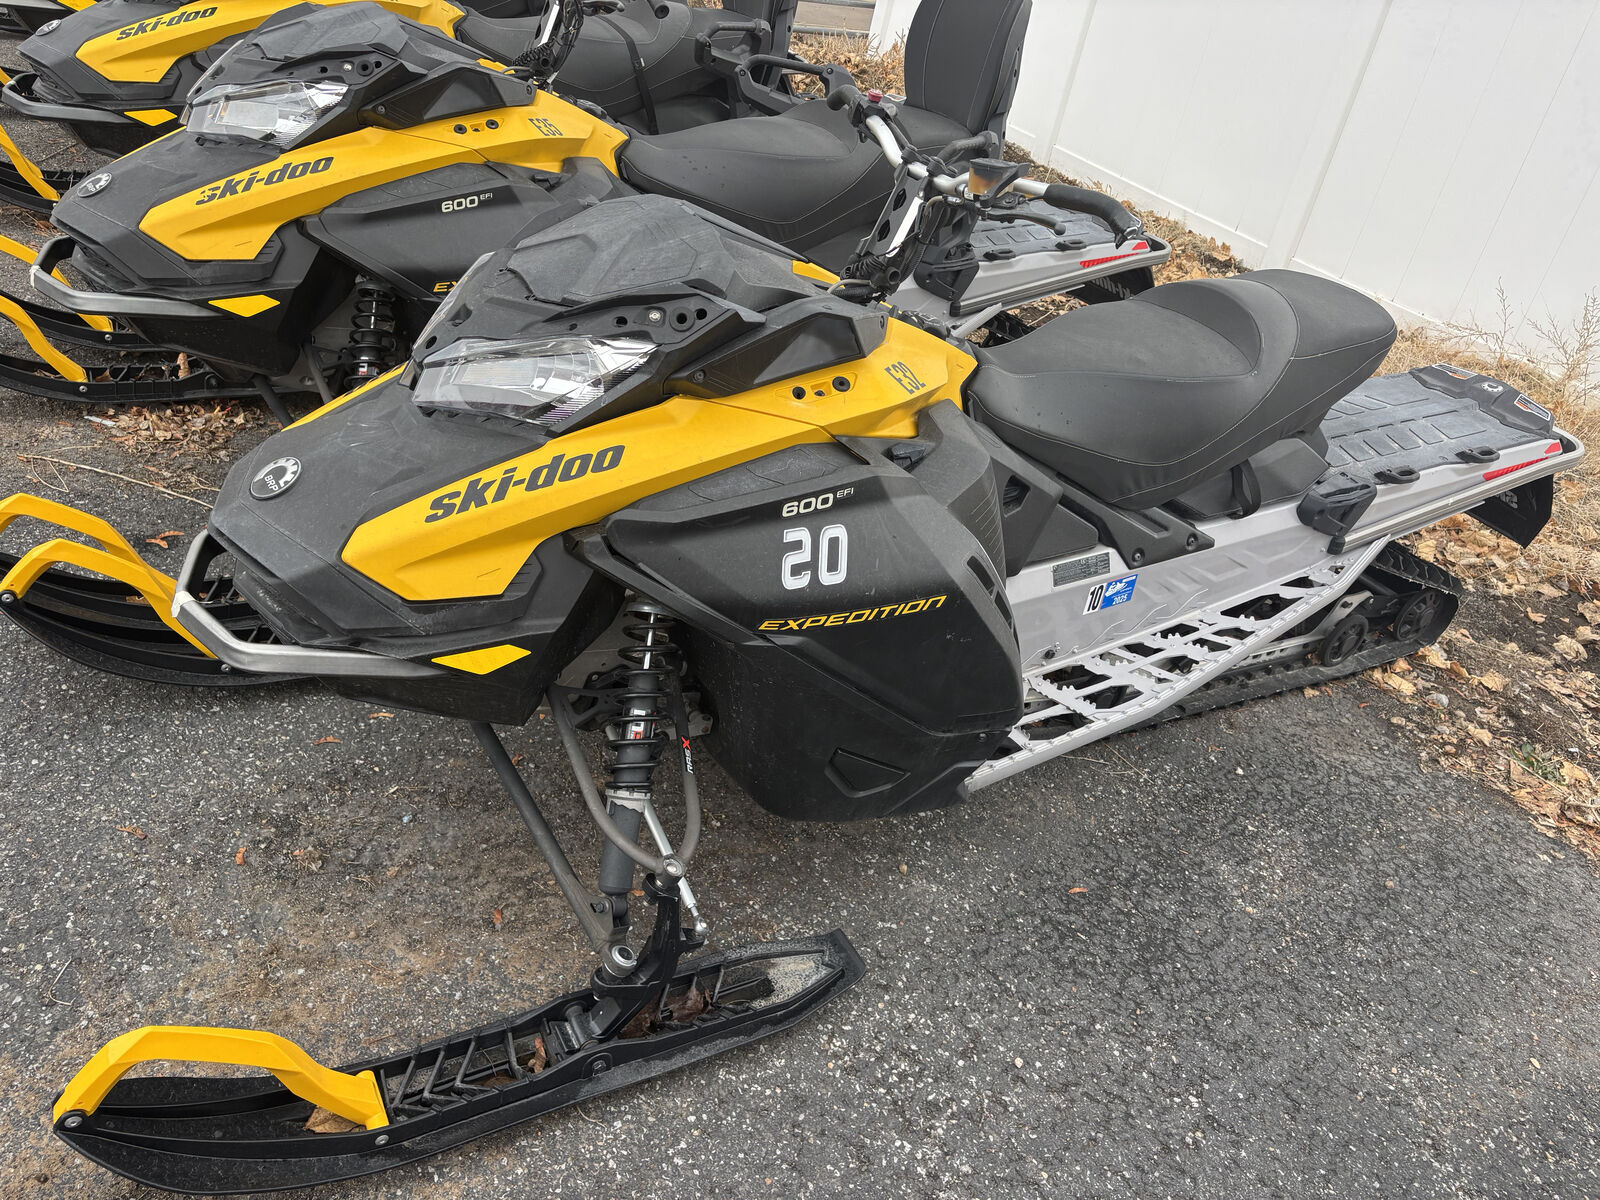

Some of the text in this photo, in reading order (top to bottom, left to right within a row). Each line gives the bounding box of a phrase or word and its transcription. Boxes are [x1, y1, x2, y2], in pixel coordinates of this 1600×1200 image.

[528, 117, 563, 137] E35
[441, 192, 493, 213] 600 EFI
[884, 361, 926, 395] E32
[264, 474, 279, 491] BRP
[782, 487, 854, 518] 600 EFI
[781, 523, 848, 590] 20
[1086, 584, 1105, 612] 10
[758, 595, 948, 631] EXPEDITION
